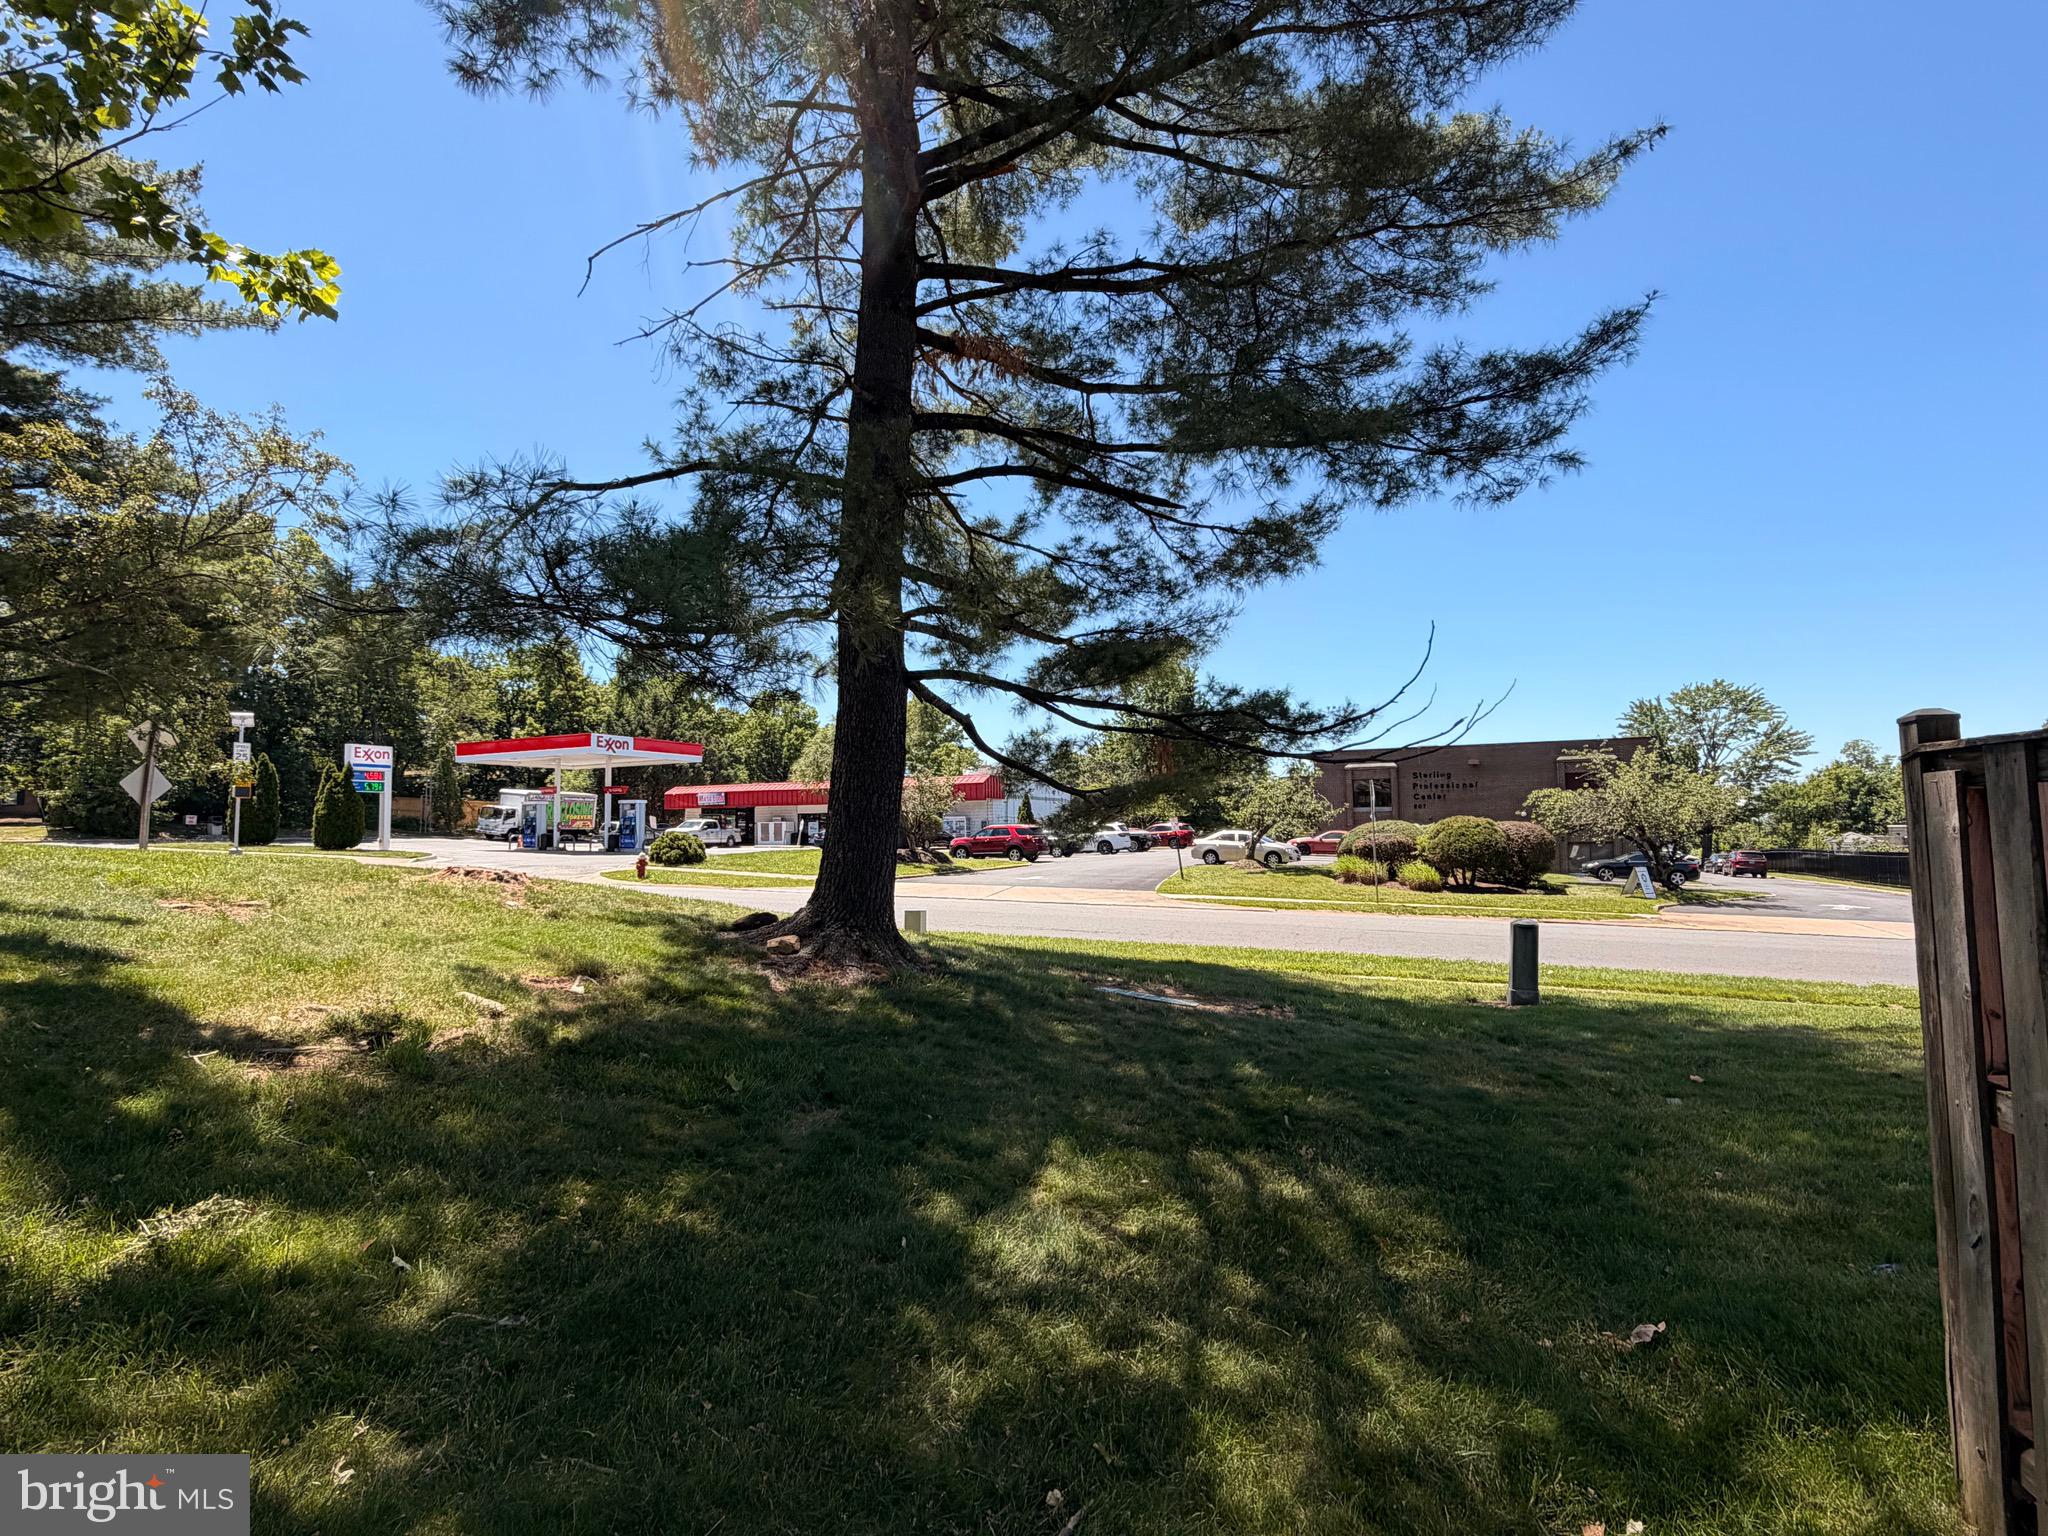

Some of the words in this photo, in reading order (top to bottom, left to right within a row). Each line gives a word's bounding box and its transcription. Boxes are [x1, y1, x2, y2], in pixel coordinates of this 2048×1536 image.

[597, 736, 629, 753] Exxon
[235, 753, 249, 761] 25
[354, 746, 390, 762] Exxon
[1412, 770, 1452, 779] Sterling
[1412, 781, 1478, 790] Professional
[1413, 792, 1446, 800] Center
